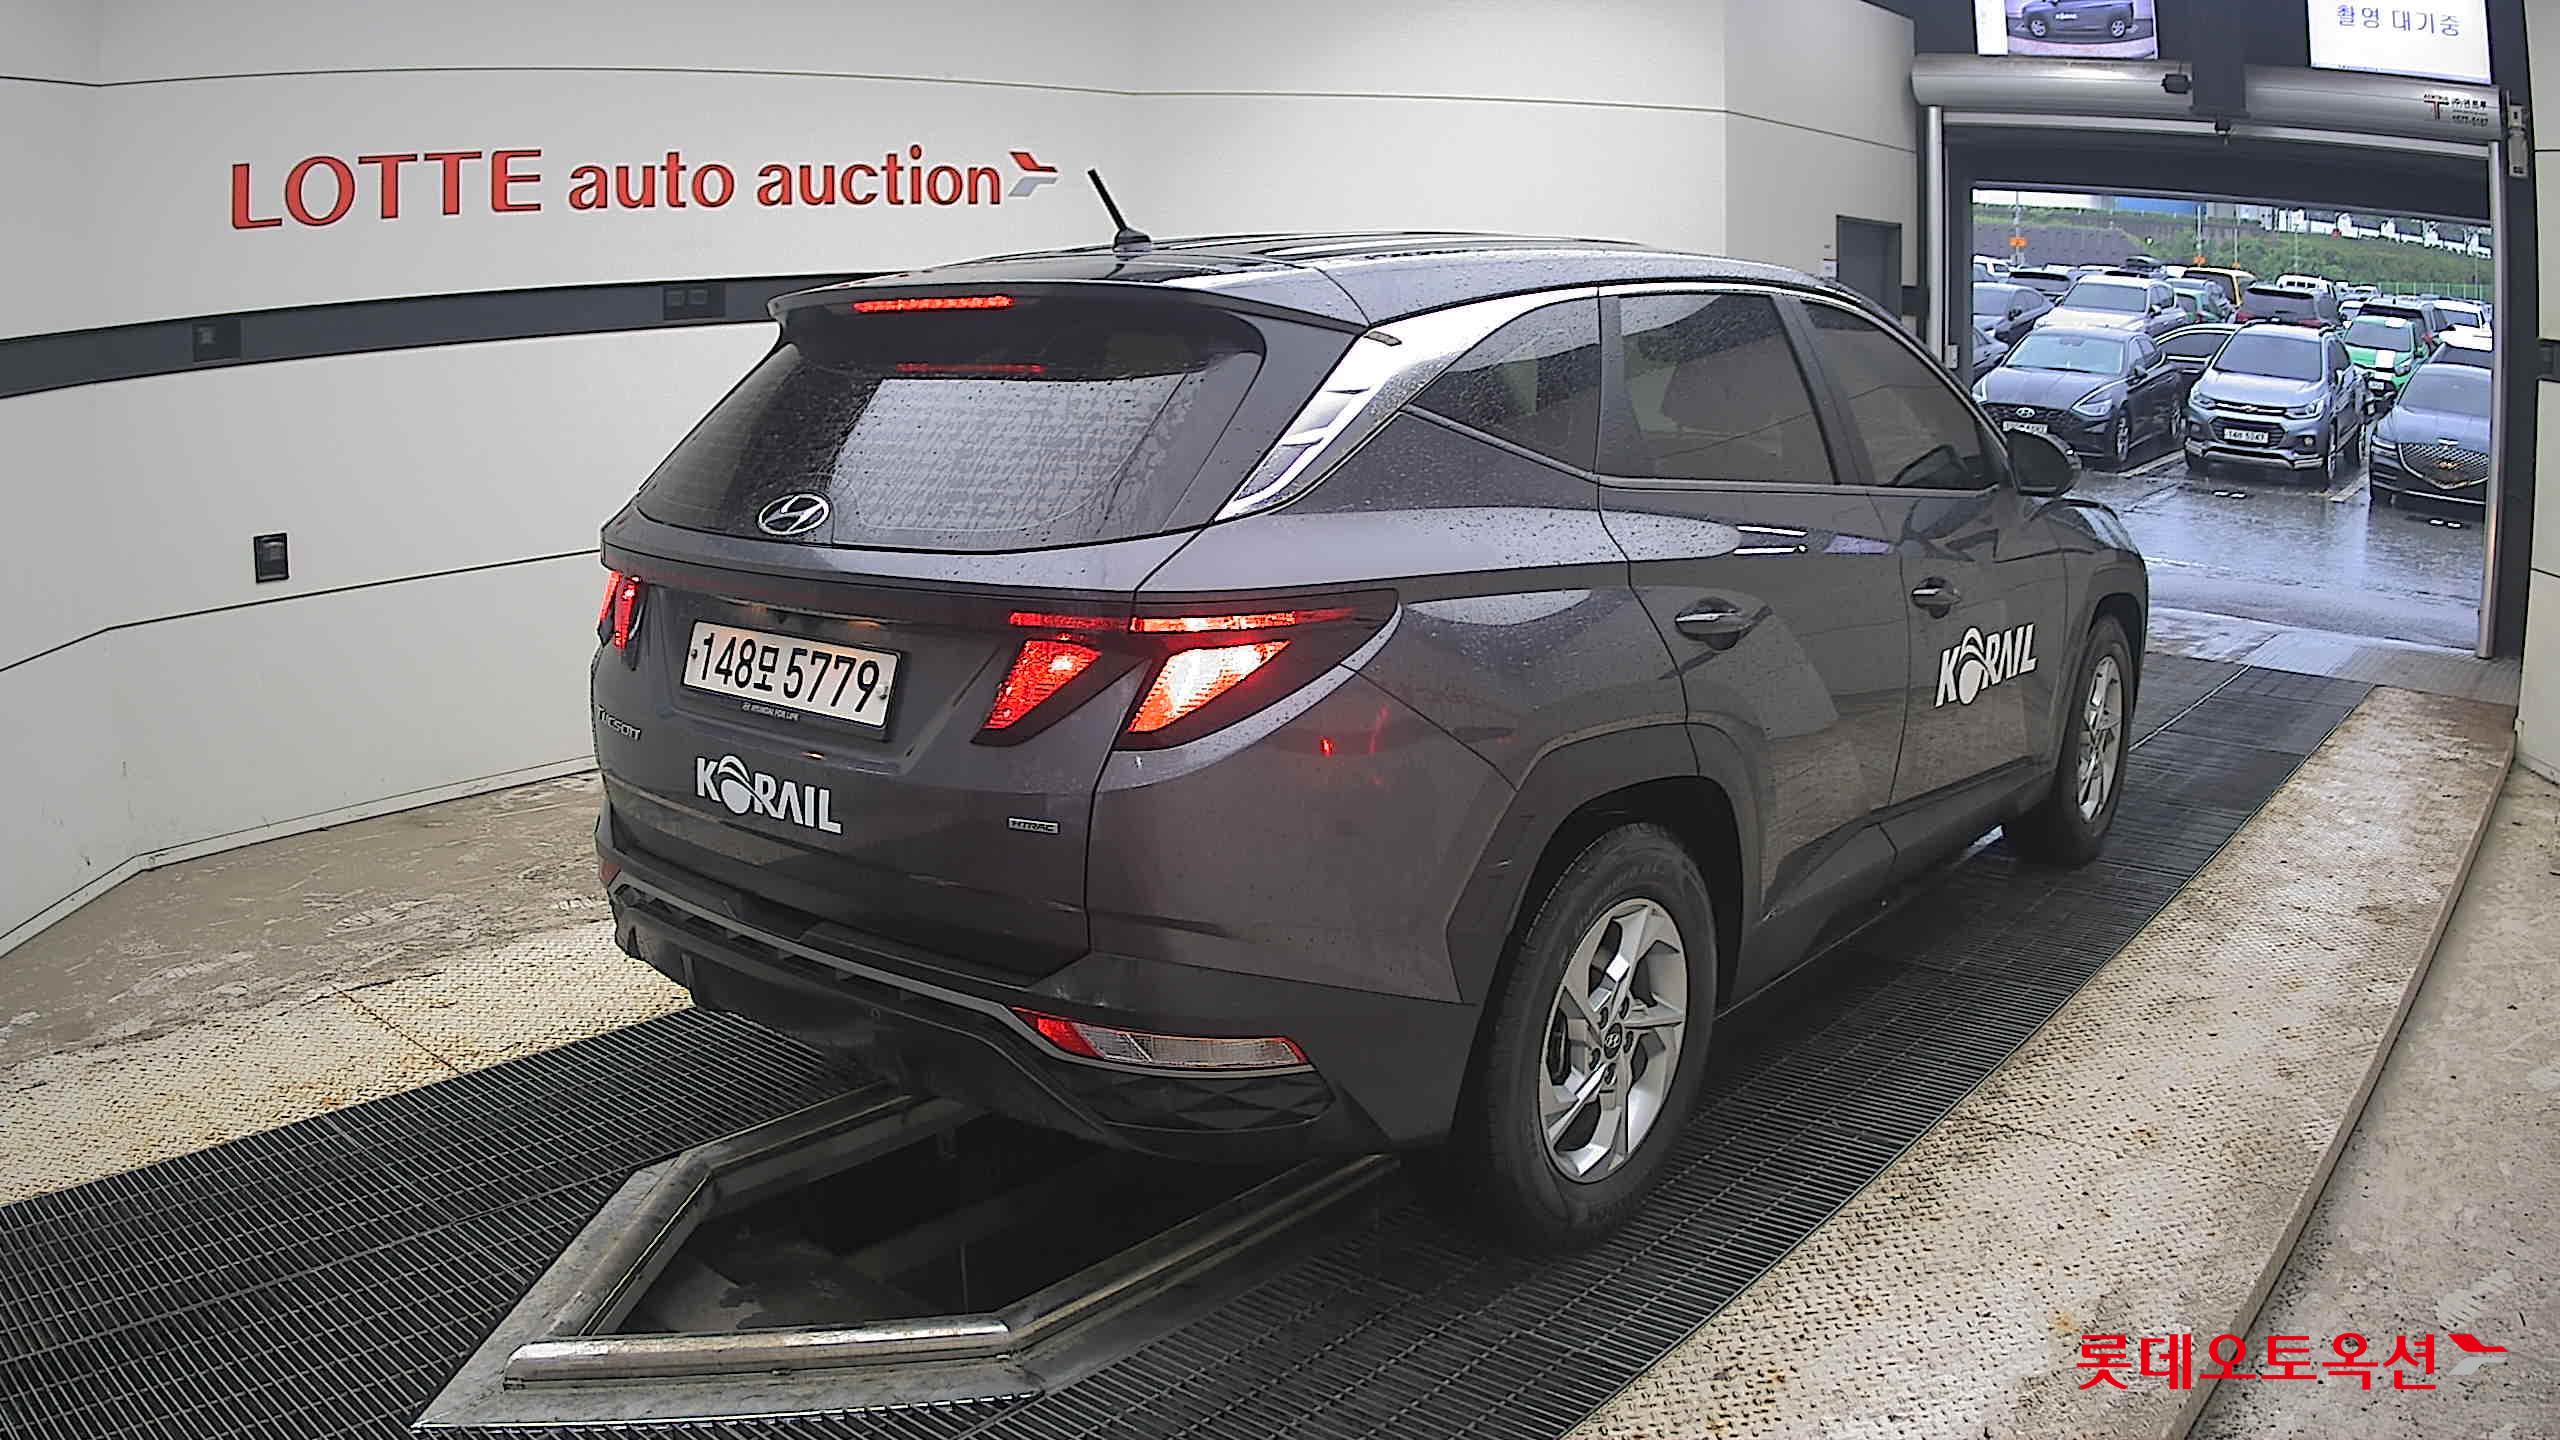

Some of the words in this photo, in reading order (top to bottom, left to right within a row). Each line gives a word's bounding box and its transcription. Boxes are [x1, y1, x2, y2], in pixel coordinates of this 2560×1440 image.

[2391, 9, 2460, 37] 대기중
[231, 150, 542, 230] LOTTE
[569, 151, 735, 210] auto
[757, 144, 1001, 206] auction
[1934, 625, 2038, 708] KORAIL
[696, 754, 842, 834] KORAIL
